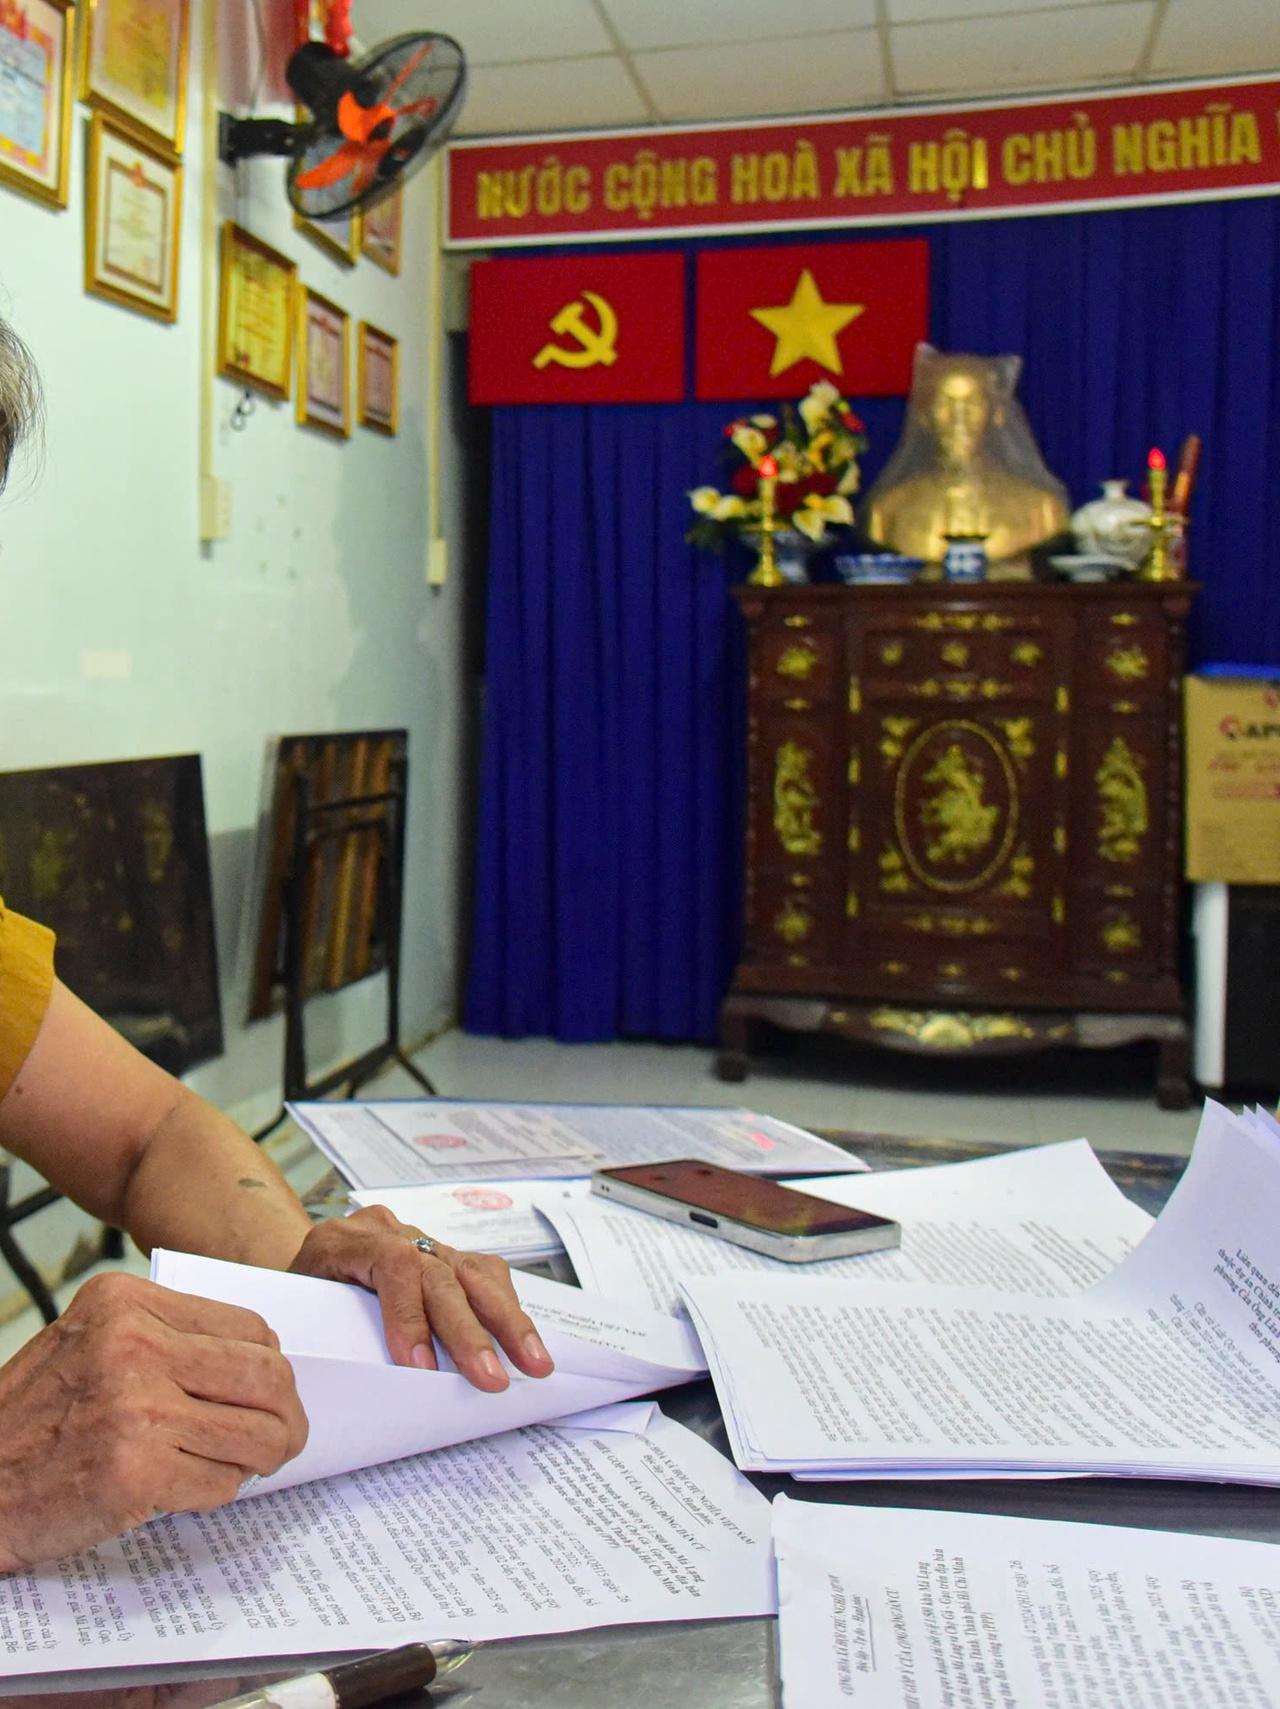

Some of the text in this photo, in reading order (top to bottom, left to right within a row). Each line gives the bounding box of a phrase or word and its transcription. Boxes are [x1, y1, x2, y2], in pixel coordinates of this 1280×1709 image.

[477, 102, 1262, 221] NƯỚC CỘNG HOÀ XÃ HỘI CHỦ NGHĨA
